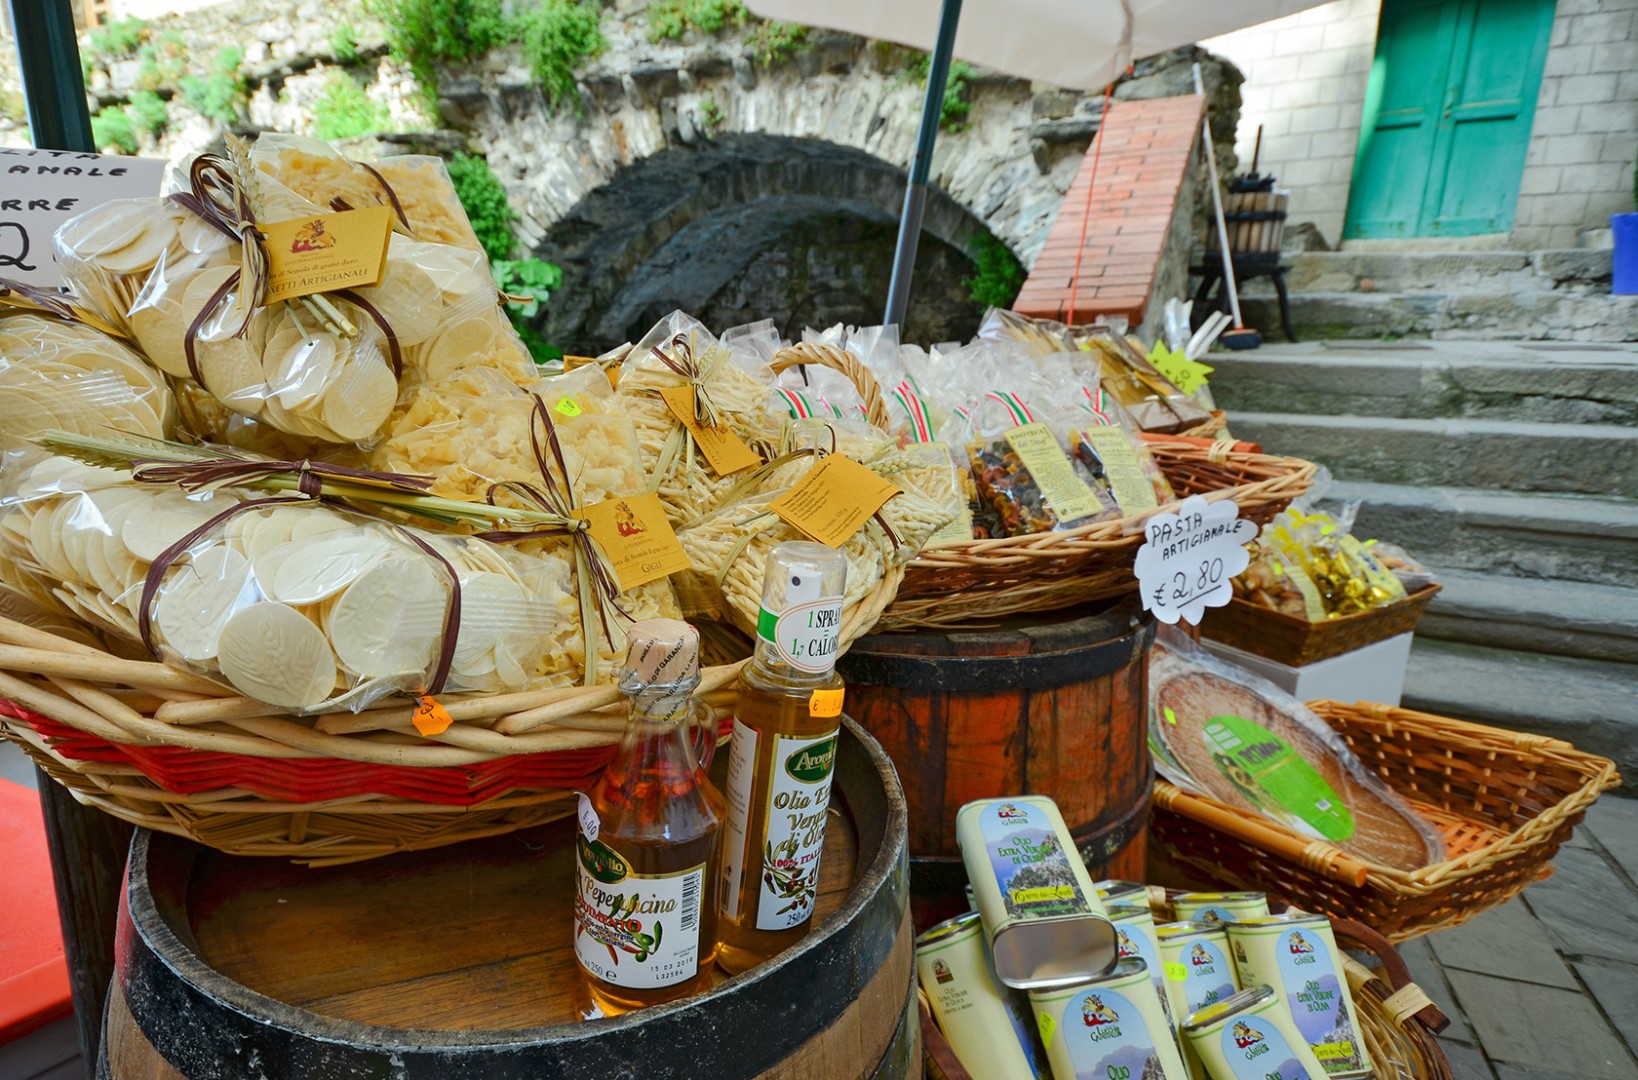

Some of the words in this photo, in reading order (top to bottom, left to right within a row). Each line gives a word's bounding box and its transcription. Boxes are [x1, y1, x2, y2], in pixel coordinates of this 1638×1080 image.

[1151, 512, 1203, 548] PASTA
[1162, 520, 1243, 561] ARTIGIANALE
[1152, 582, 1167, 607] €
[1172, 557, 1224, 599] 2,80
[807, 610, 814, 628] 1
[773, 789, 812, 810] Olio
[584, 875, 678, 915] Peperoncino
